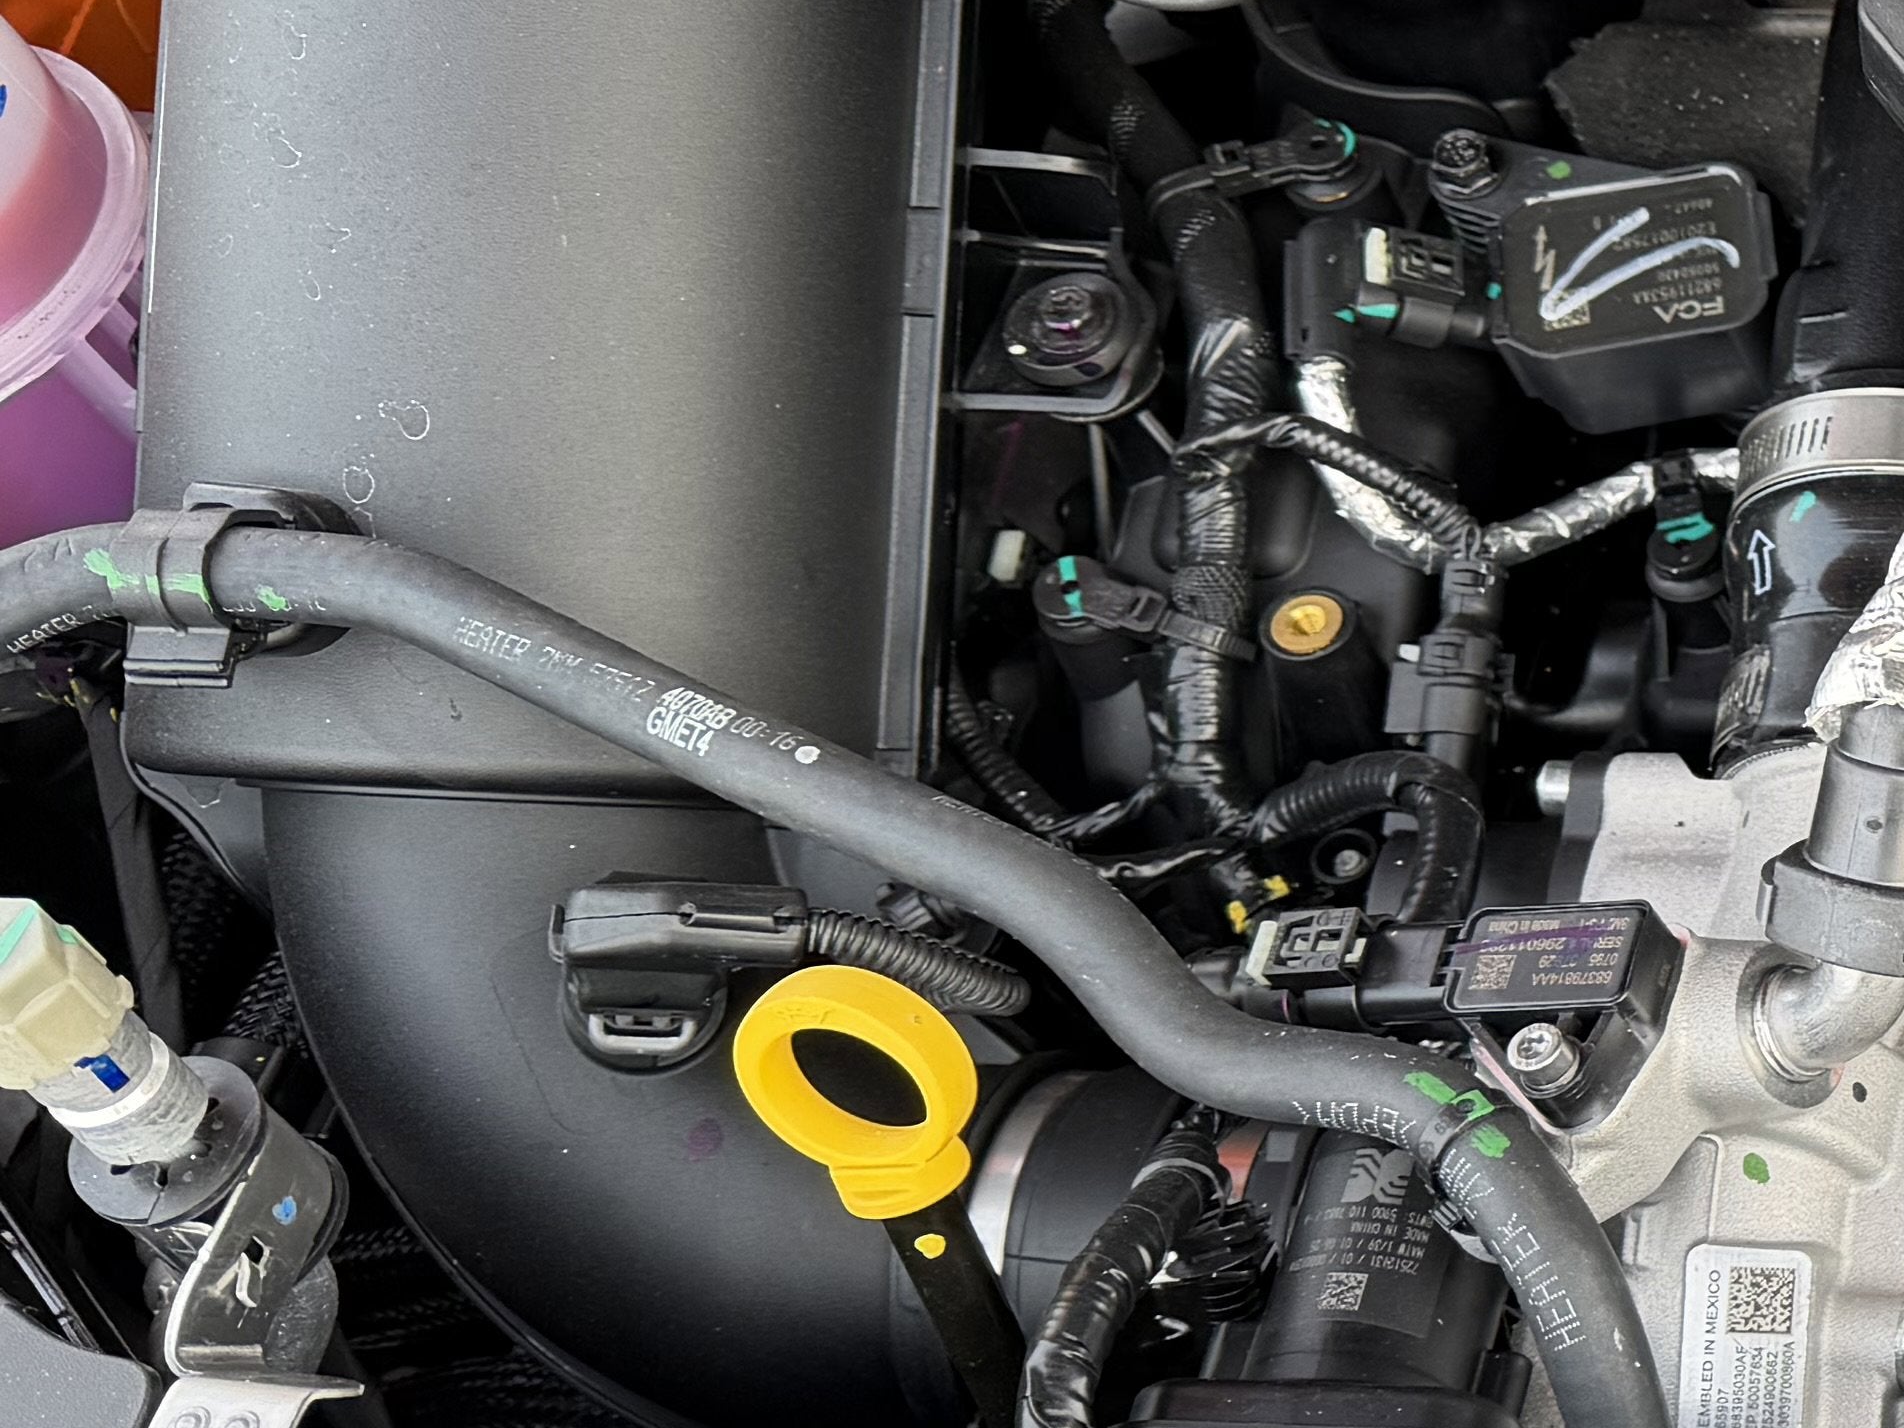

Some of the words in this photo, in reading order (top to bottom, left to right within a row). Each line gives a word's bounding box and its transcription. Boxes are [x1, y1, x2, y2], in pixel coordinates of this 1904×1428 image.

[1652, 295, 1725, 324] FCA
[1705, 1270, 1721, 1335] MEXICO
[1704, 1339, 1716, 1355] IN
